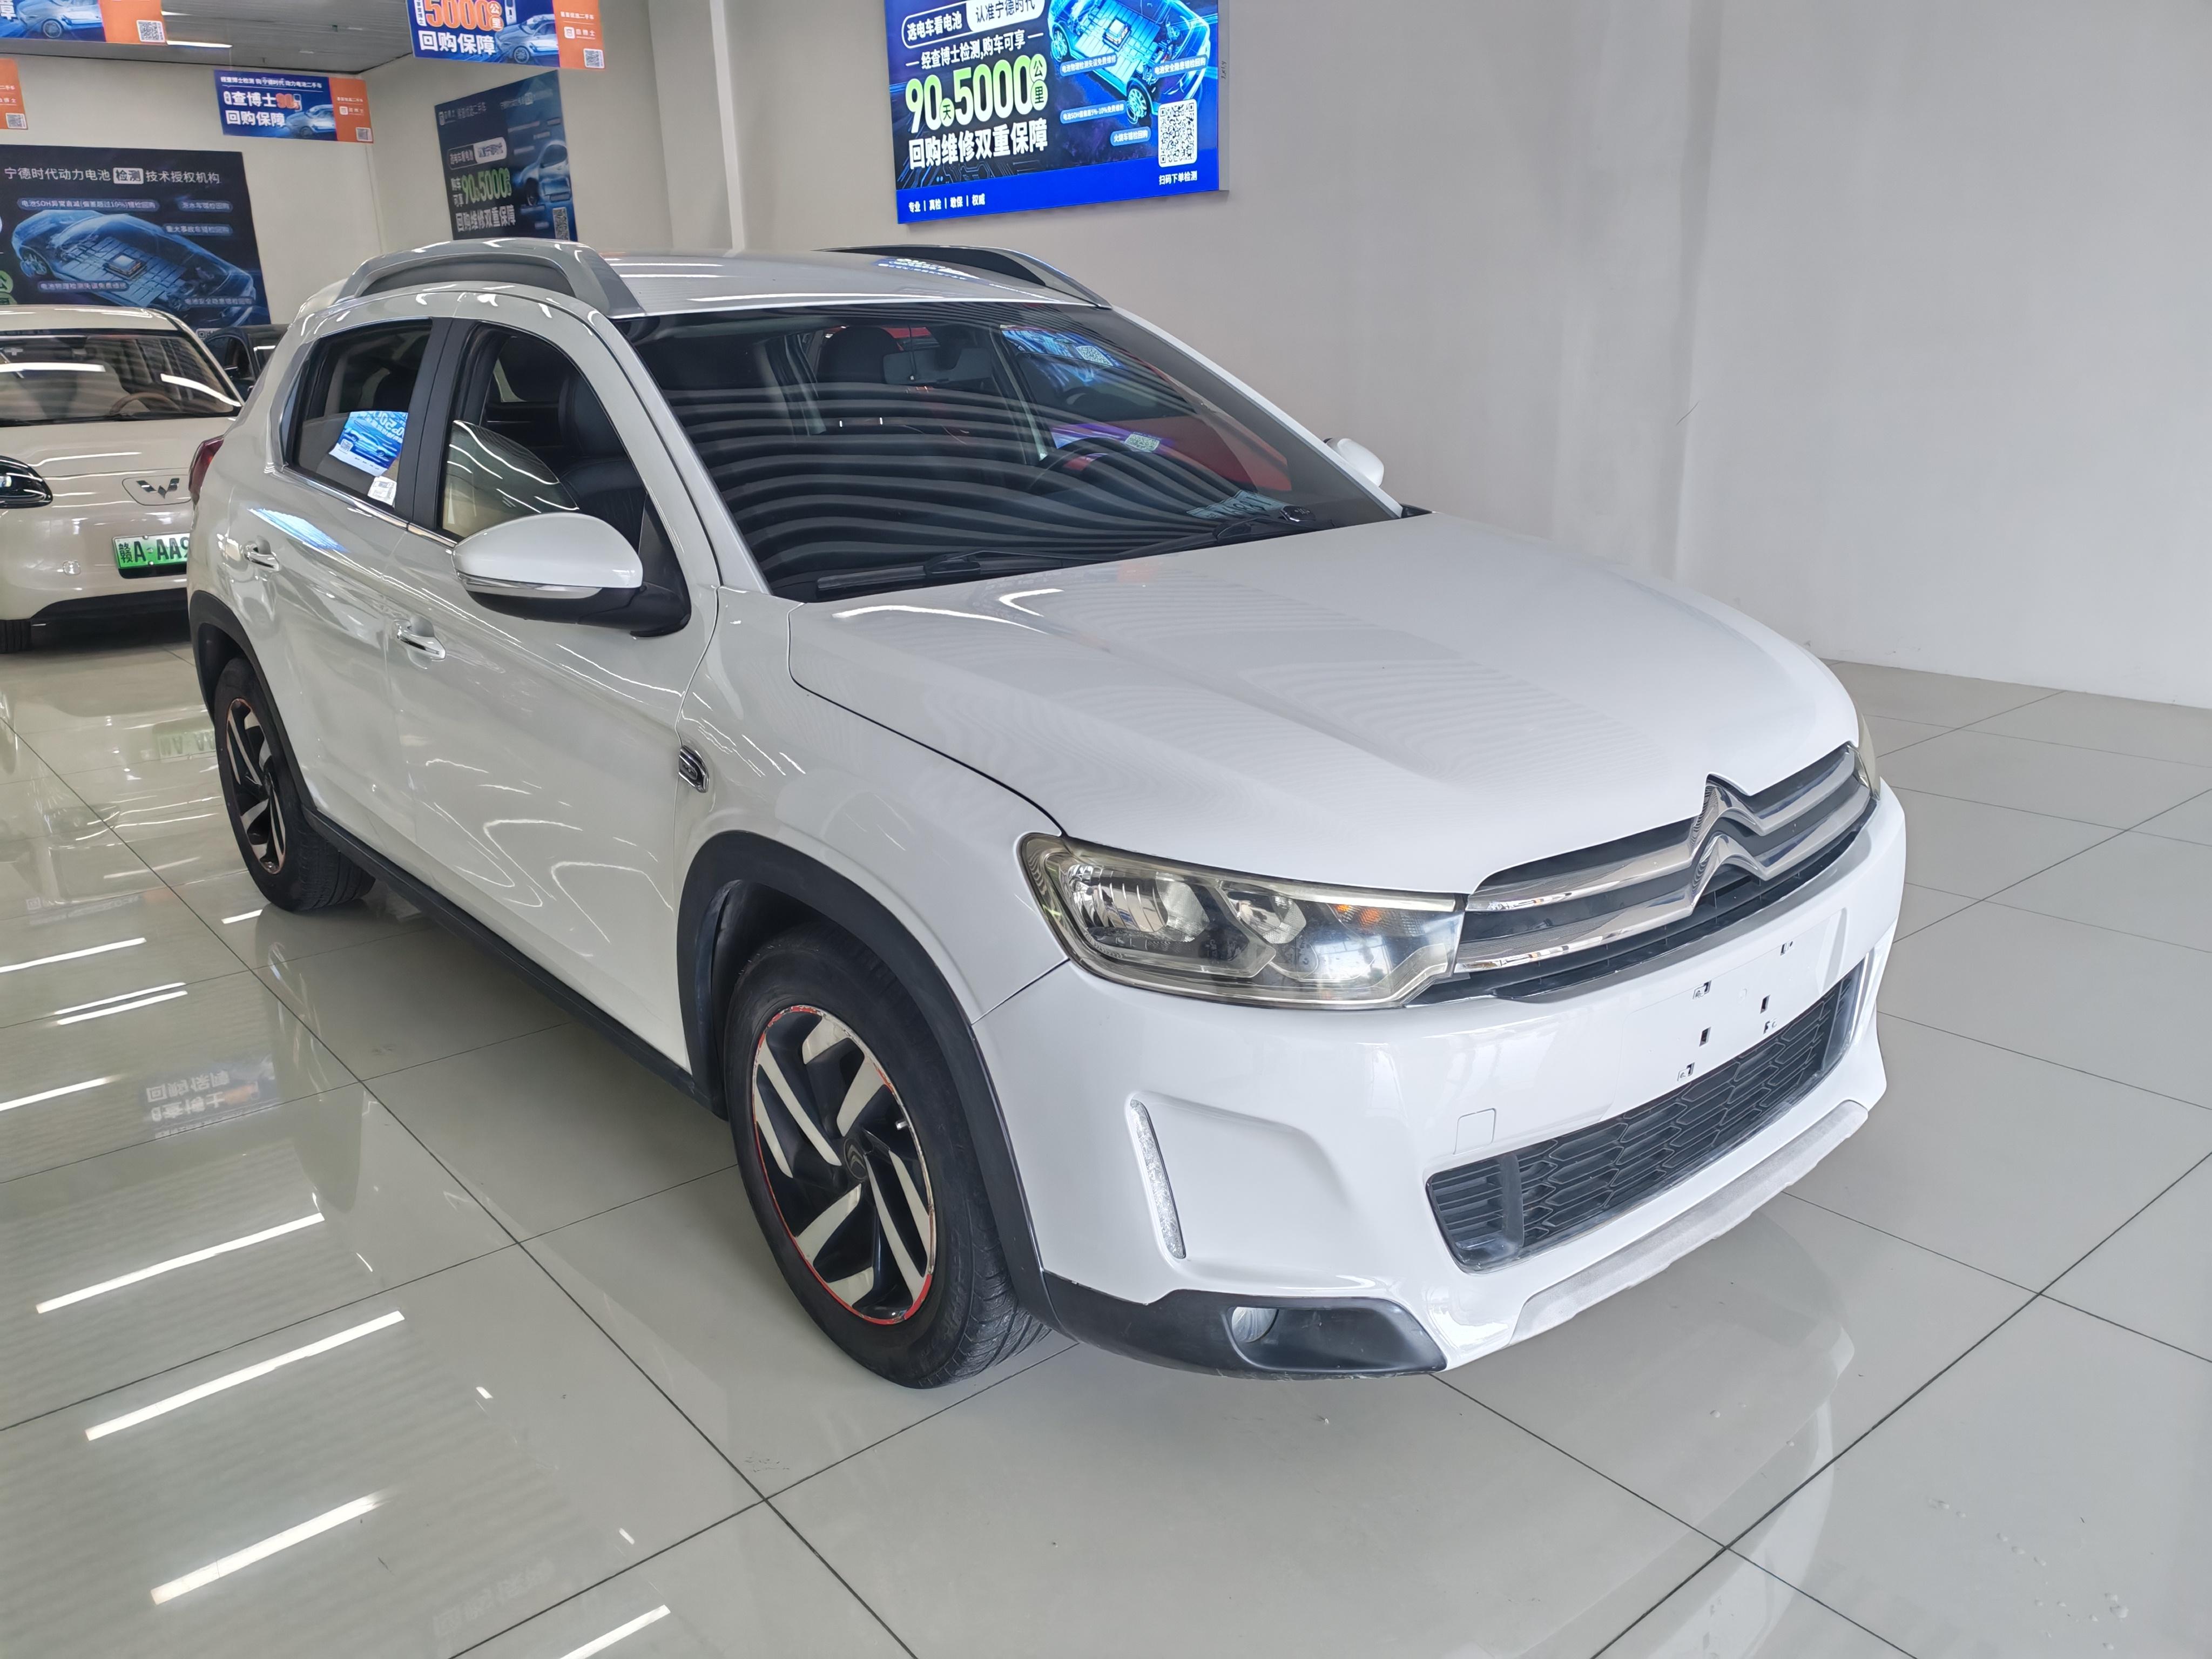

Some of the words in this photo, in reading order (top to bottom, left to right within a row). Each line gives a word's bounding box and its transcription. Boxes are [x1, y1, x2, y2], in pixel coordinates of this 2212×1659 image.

[907, 11, 962, 42] 选电车看电池
[418, 30, 496, 55] 回购保障
[225, 110, 286, 127] 回购保障
[909, 118, 1048, 170] 回购维修双重保障
[4, 167, 111, 181] 宁德时代动力电池
[115, 170, 141, 182] 检测
[146, 170, 220, 184] 技术授权机构
[1159, 171, 1198, 185] 扫码下单检测
